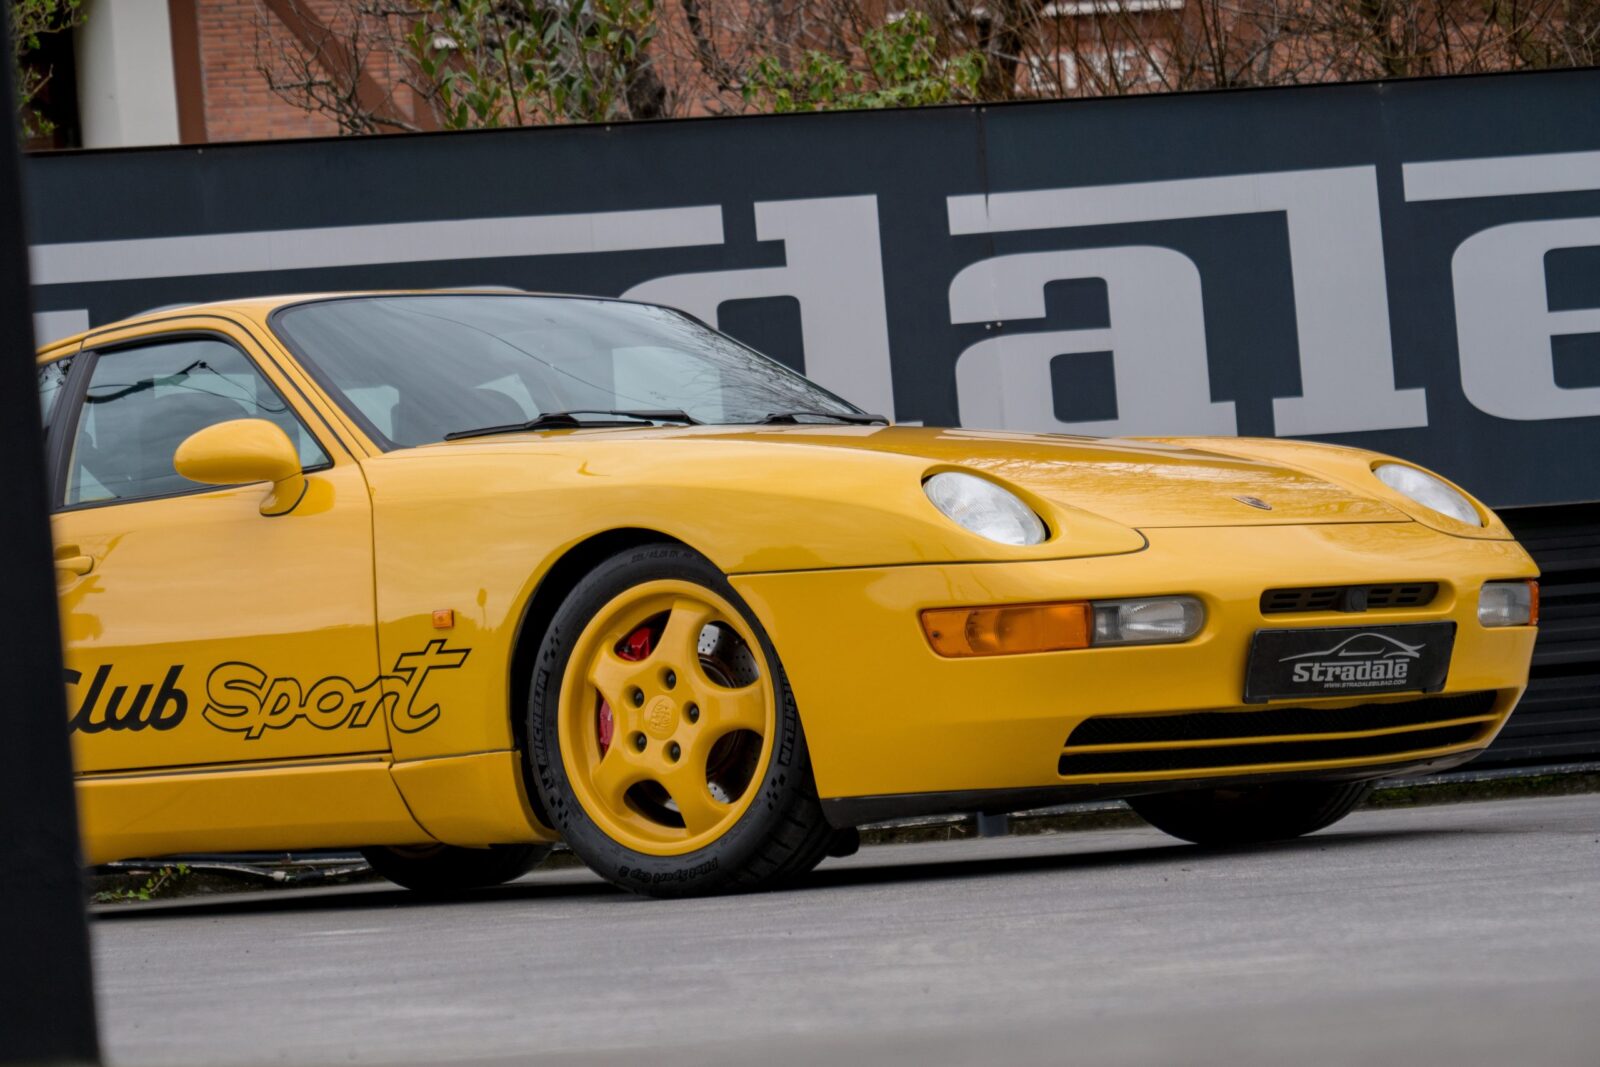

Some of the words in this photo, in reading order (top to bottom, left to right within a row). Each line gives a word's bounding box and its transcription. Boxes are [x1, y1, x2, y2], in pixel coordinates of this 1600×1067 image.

[30, 151, 1600, 436] dale
[202, 638, 471, 741] Sport
[533, 669, 549, 766] MICHELIN
[1292, 658, 1410, 682] Stradale
